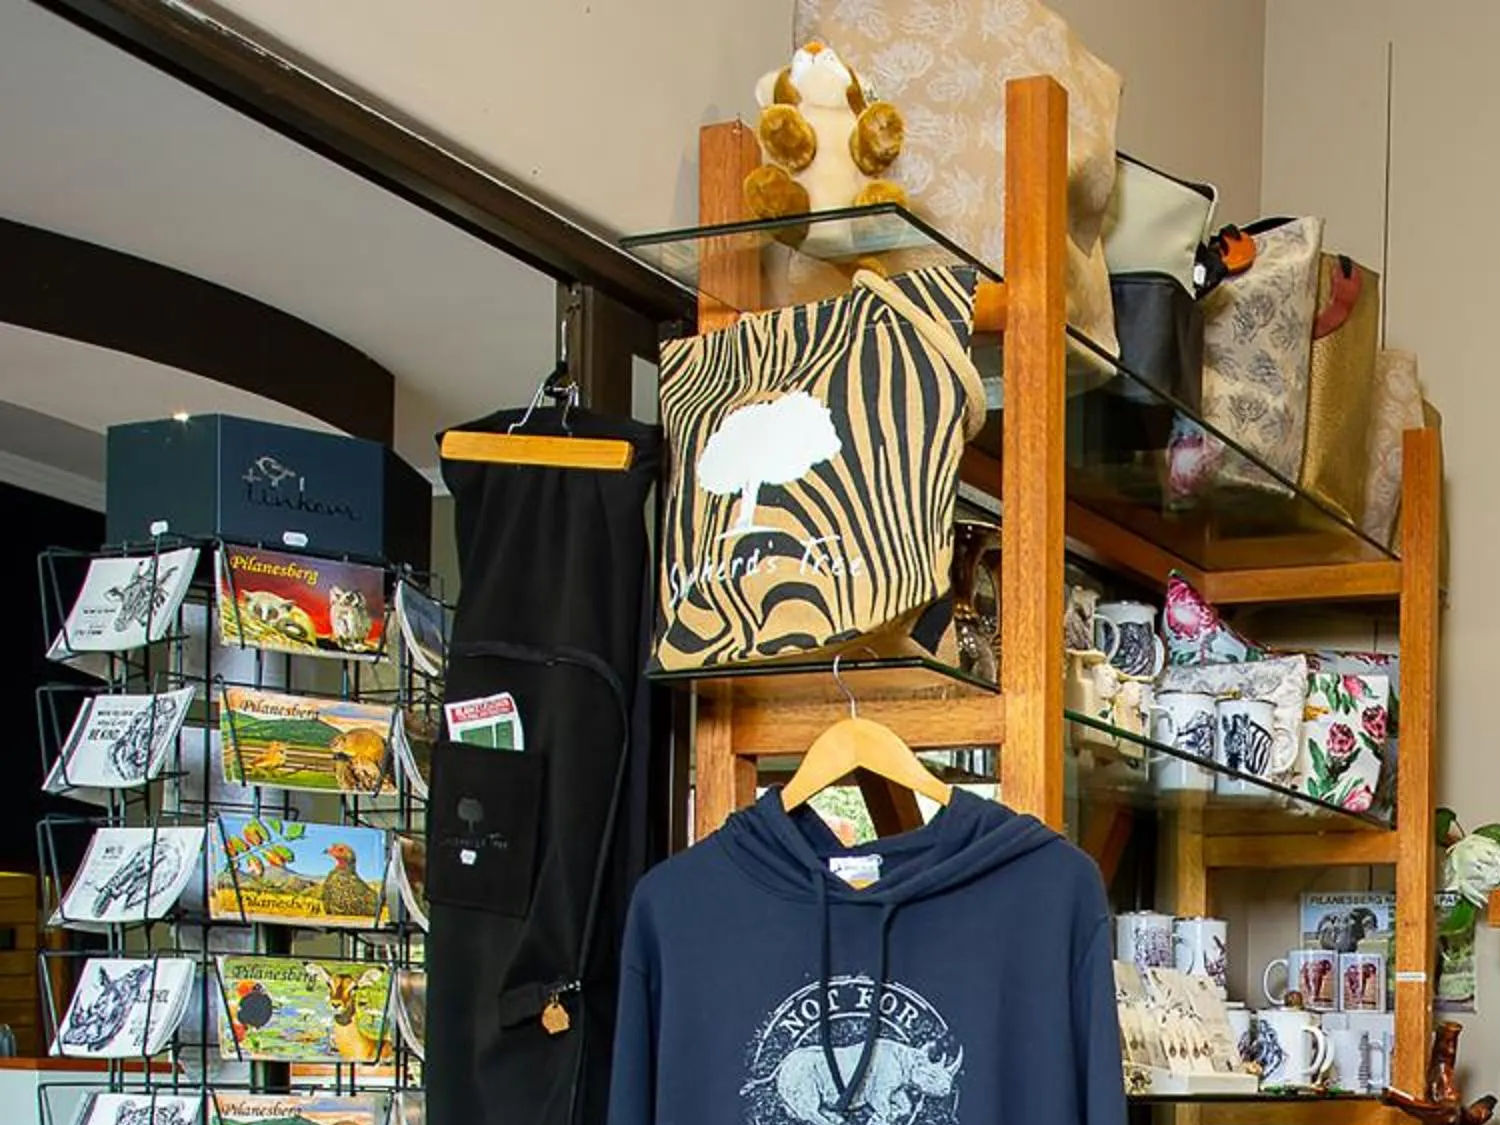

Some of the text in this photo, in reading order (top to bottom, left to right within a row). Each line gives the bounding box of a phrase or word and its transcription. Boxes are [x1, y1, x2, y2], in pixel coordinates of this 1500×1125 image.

[230, 555, 319, 585] Pilanesberg
[800, 533, 863, 577] Tree
[239, 700, 321, 721] Pilanesberg
[231, 963, 319, 992] Pilanesberg
[779, 986, 919, 1038] NOT FOR
